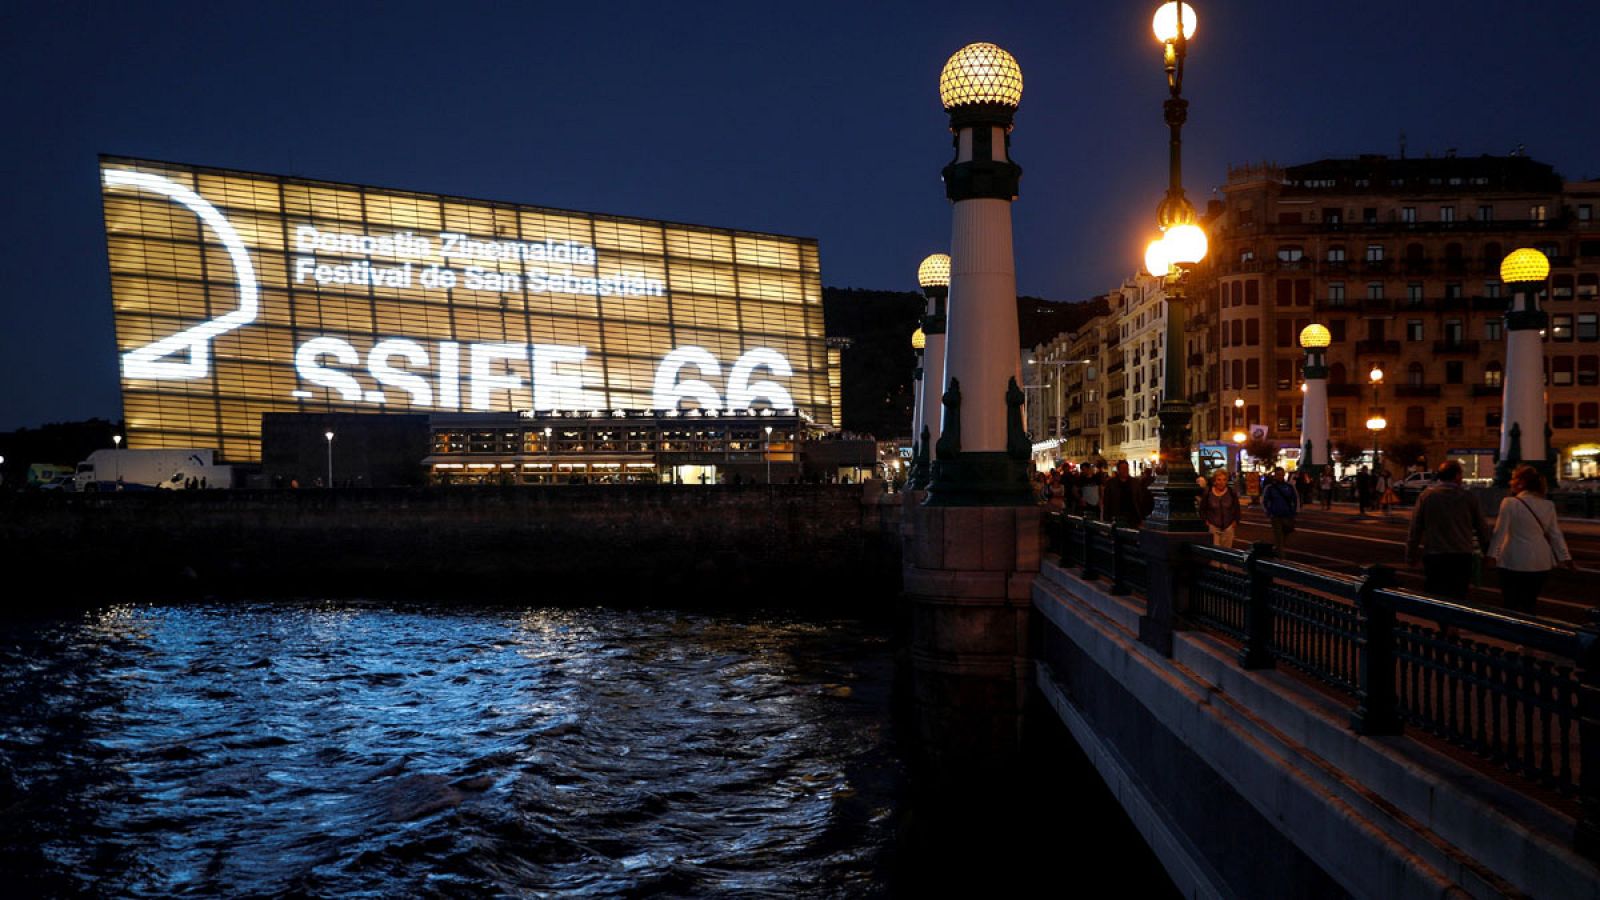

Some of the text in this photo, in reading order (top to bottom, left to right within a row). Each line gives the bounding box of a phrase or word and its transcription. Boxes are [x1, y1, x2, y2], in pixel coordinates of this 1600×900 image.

[296, 226, 596, 265] Donostia Zinemaldia
[295, 257, 411, 289] Festival
[420, 263, 457, 289] de
[464, 266, 521, 292] San
[653, 345, 794, 410] 66
